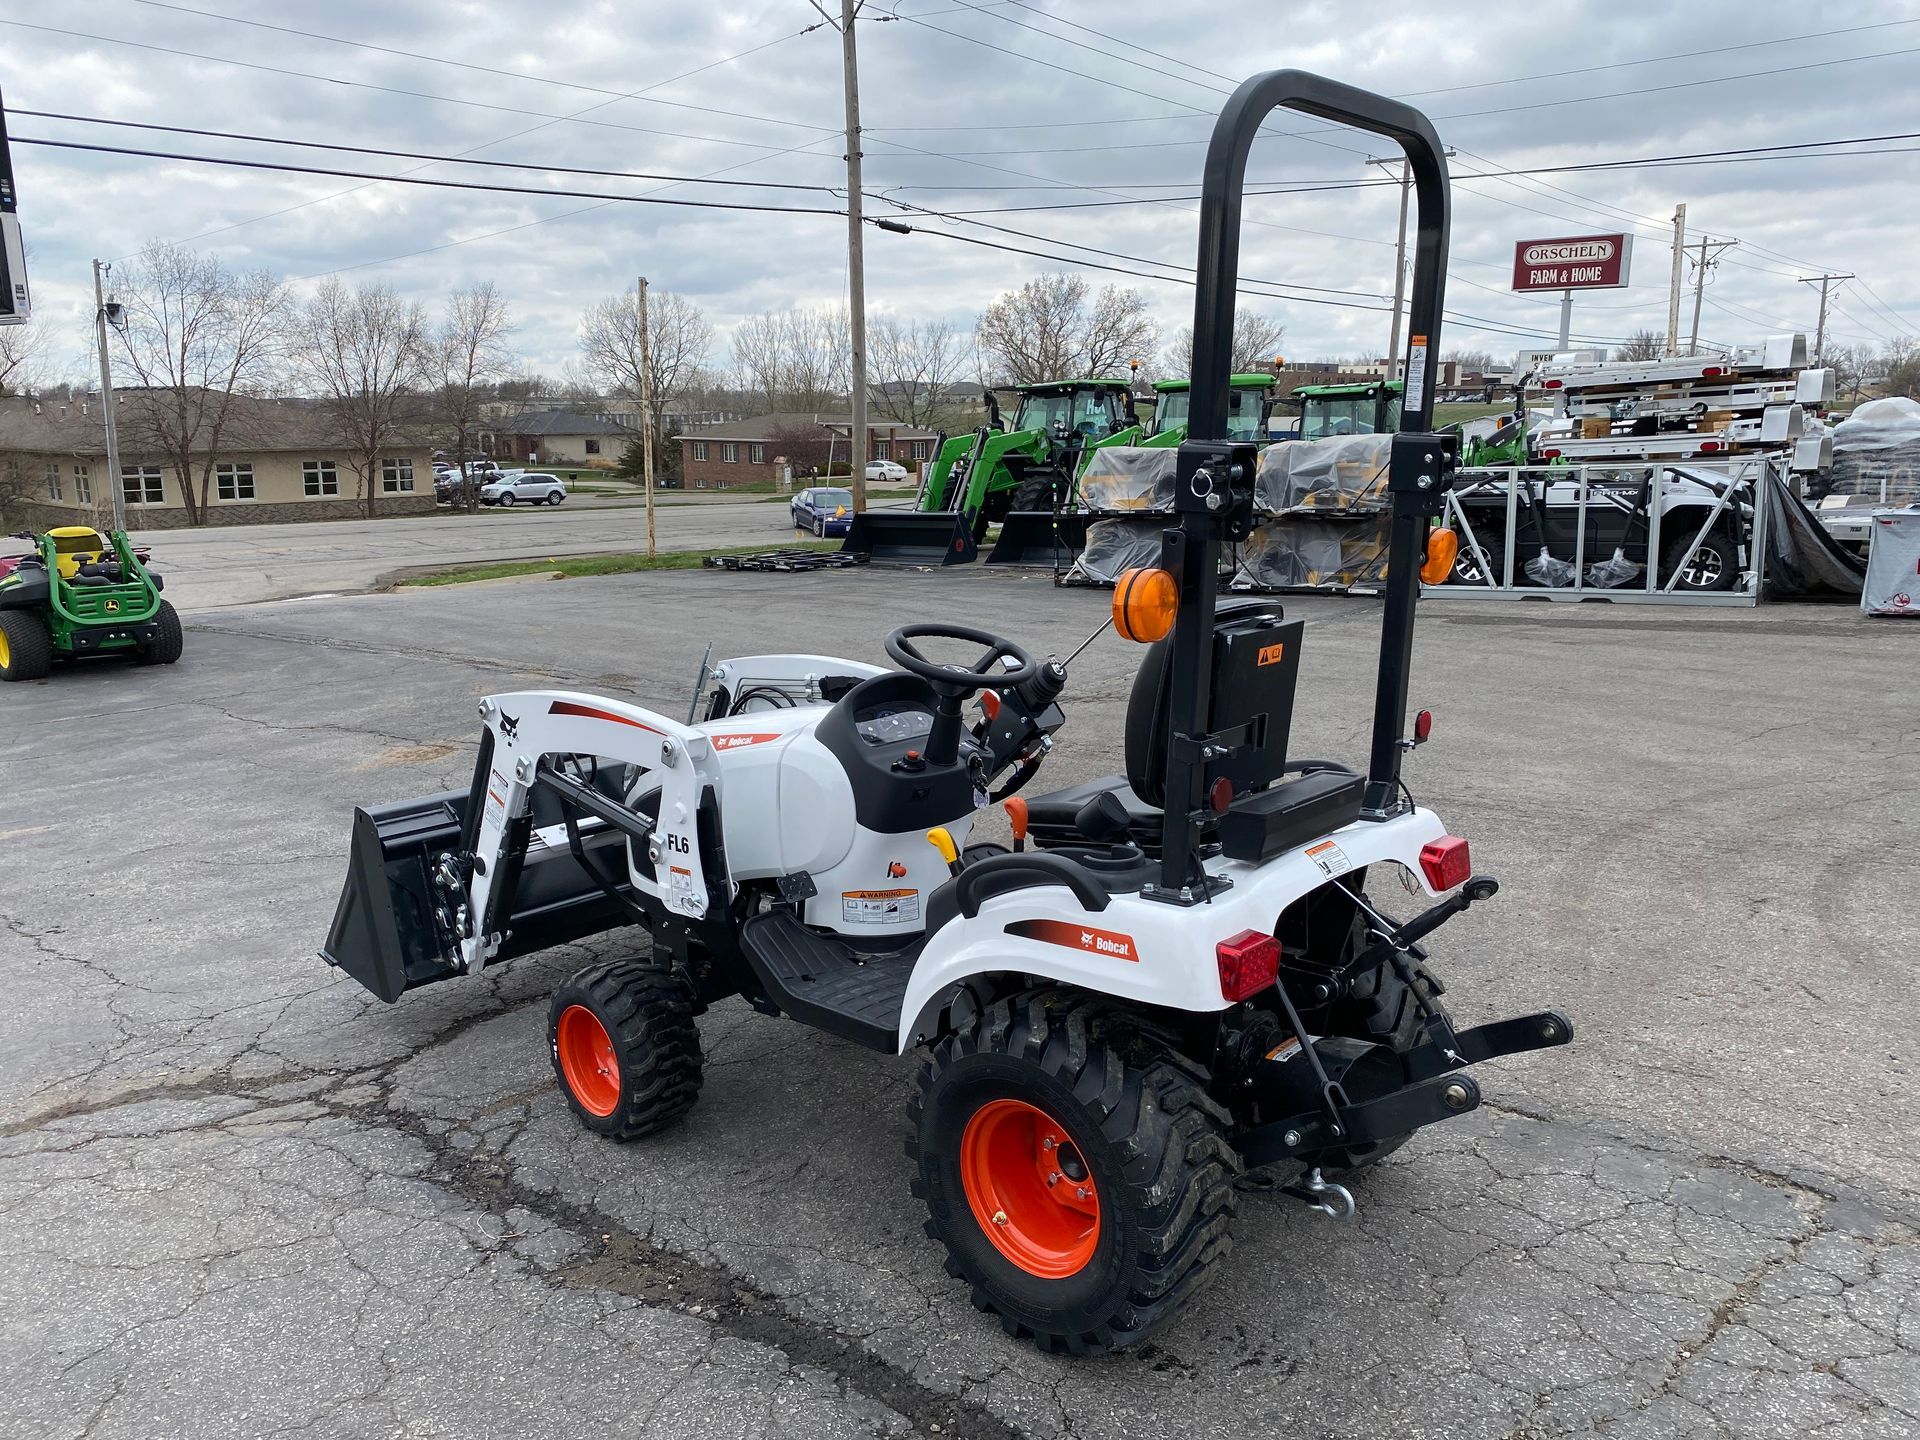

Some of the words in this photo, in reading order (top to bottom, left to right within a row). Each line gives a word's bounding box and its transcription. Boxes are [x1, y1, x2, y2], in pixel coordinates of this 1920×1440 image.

[1529, 244, 1607, 261] ORSCHELN
[1530, 269, 1558, 285] FARM
[1560, 271, 1568, 283] &
[1571, 266, 1602, 282] HOME
[1531, 354, 1555, 362] INVEN
[728, 736, 754, 747] Bobcat
[667, 833, 690, 854] FL6
[866, 890, 901, 899] WARNING
[1096, 936, 1129, 955] Bobcat
